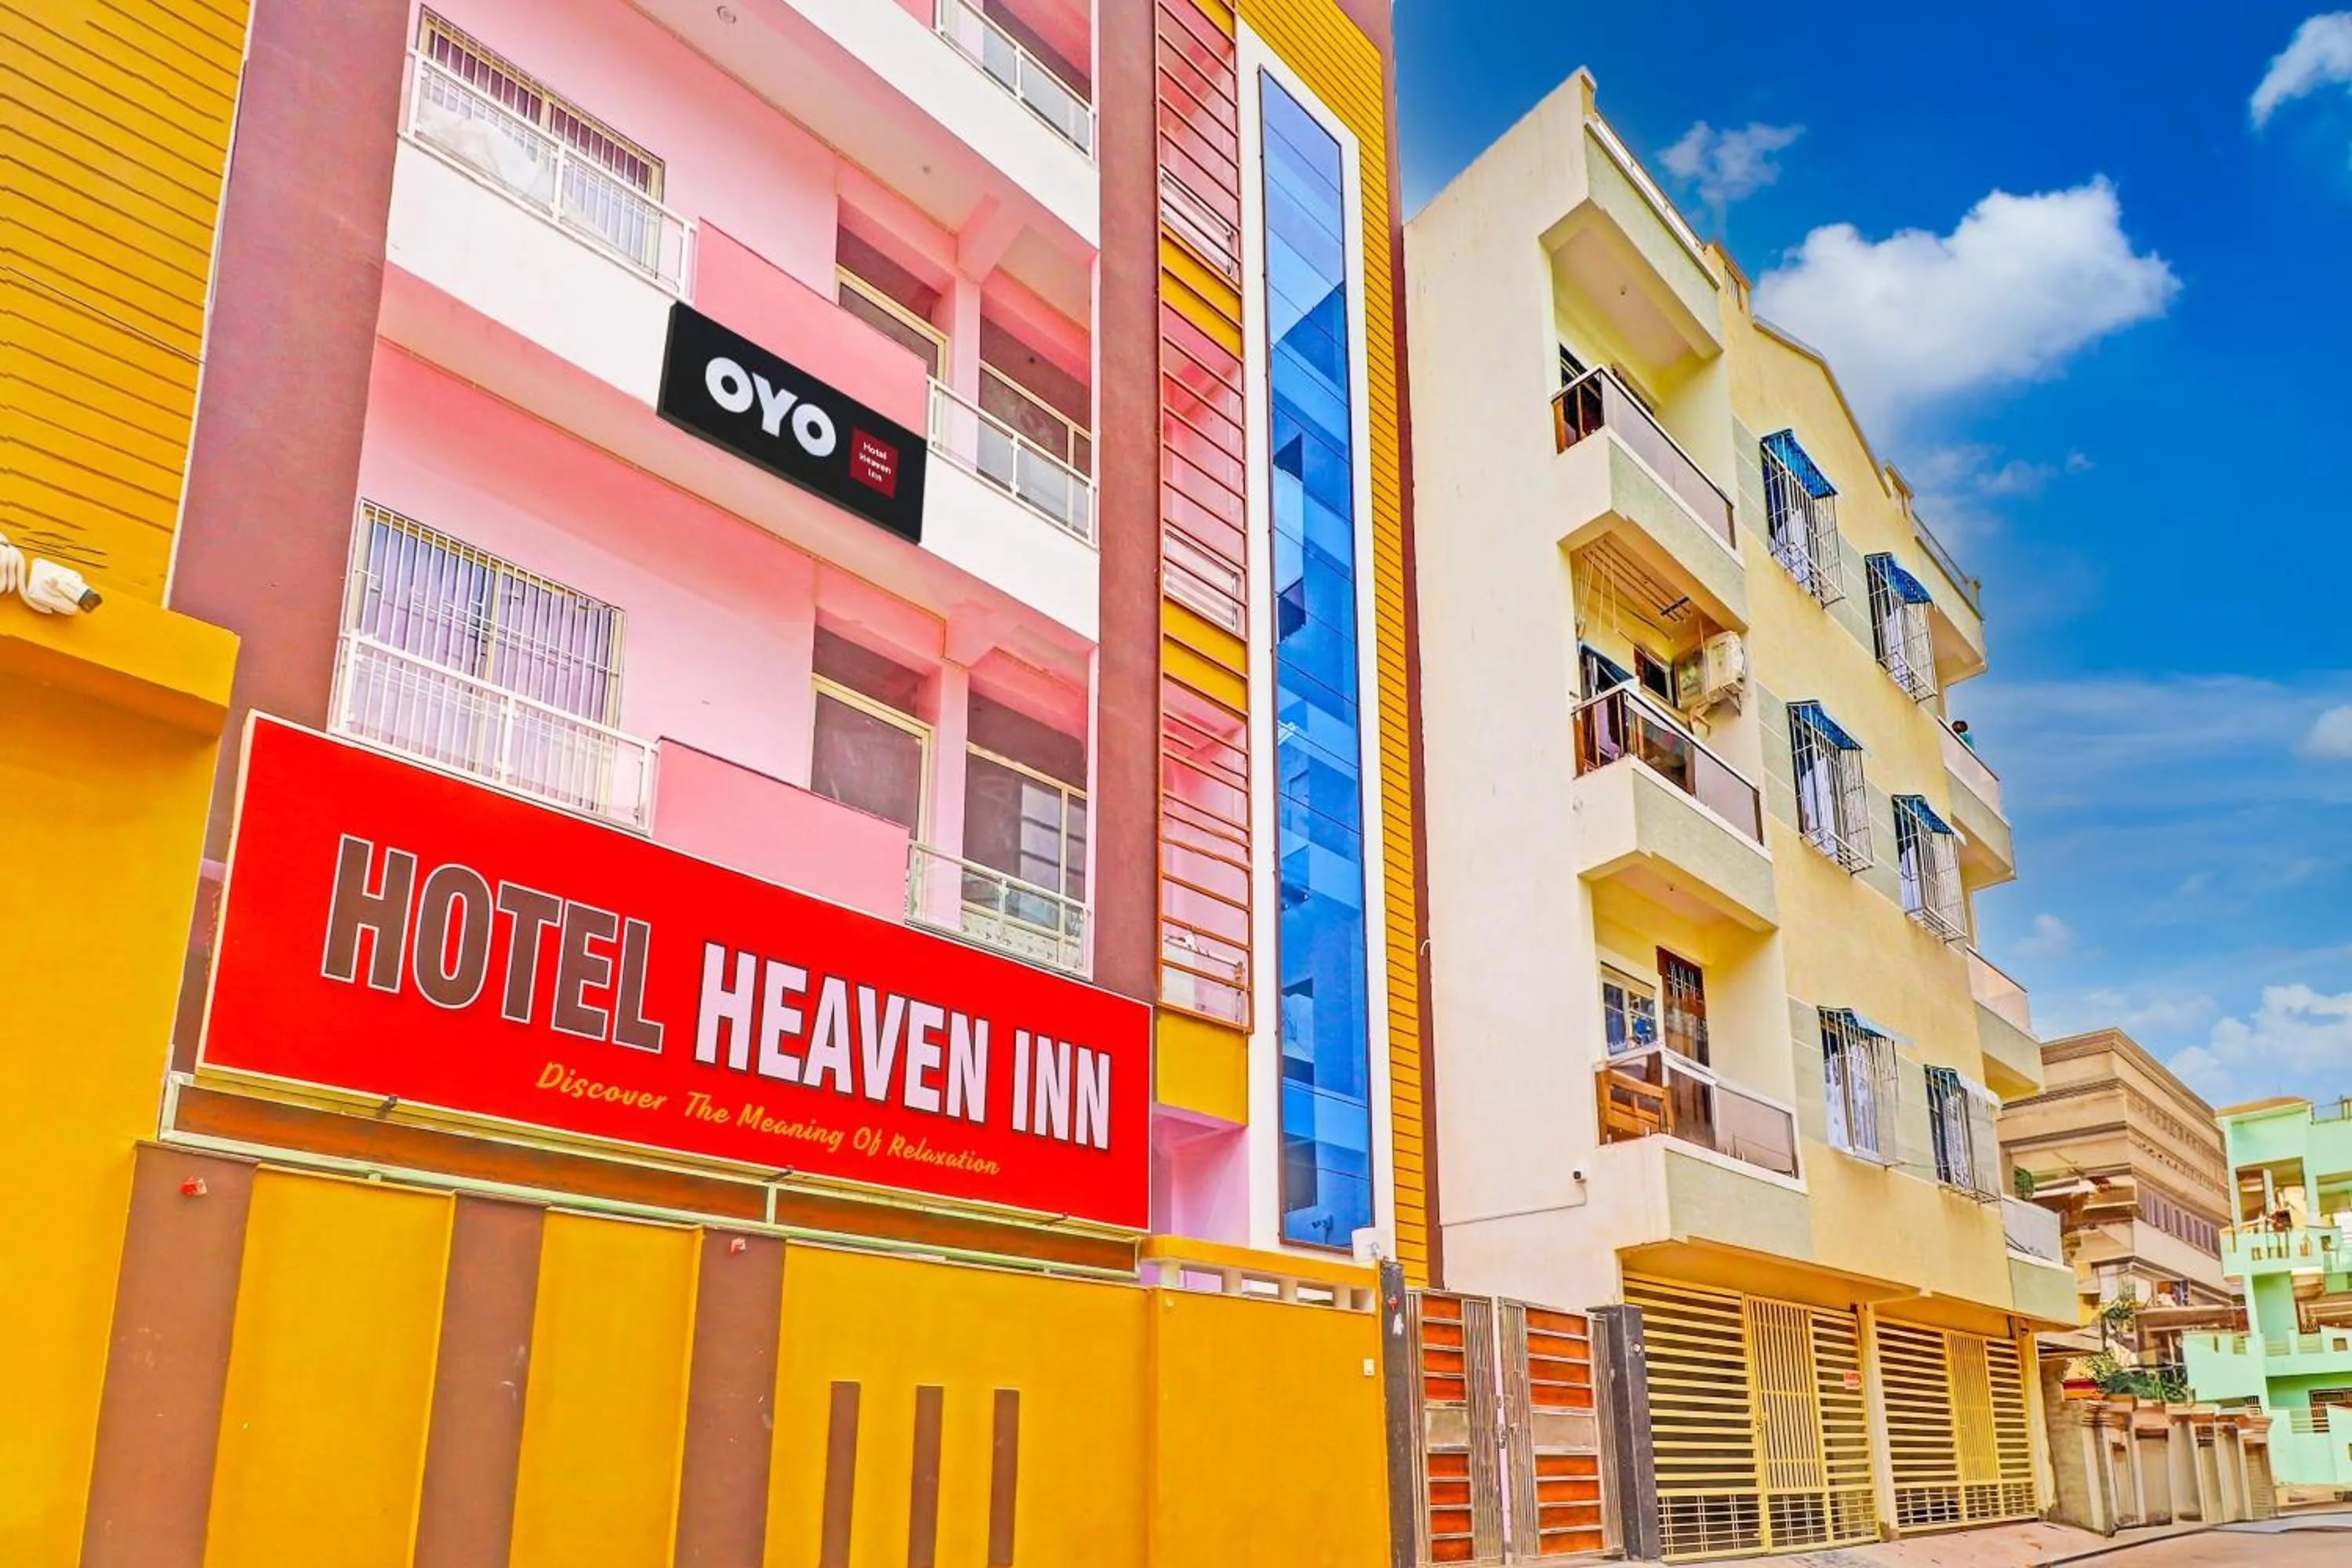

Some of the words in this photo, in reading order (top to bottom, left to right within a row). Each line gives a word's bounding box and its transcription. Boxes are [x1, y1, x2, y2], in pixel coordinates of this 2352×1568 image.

[706, 357, 836, 457] OYO
[863, 441, 887, 460] Hotel
[868, 468, 882, 482] Inn
[321, 833, 664, 1054] HOTEL
[693, 940, 990, 1124] HEAVEN
[1011, 1027, 1112, 1152] INN
[535, 1061, 668, 1110] Discover
[684, 1091, 731, 1123] The
[736, 1103, 844, 1152] Meaning
[853, 1127, 882, 1156] Of
[887, 1133, 1000, 1175] Relaxation
